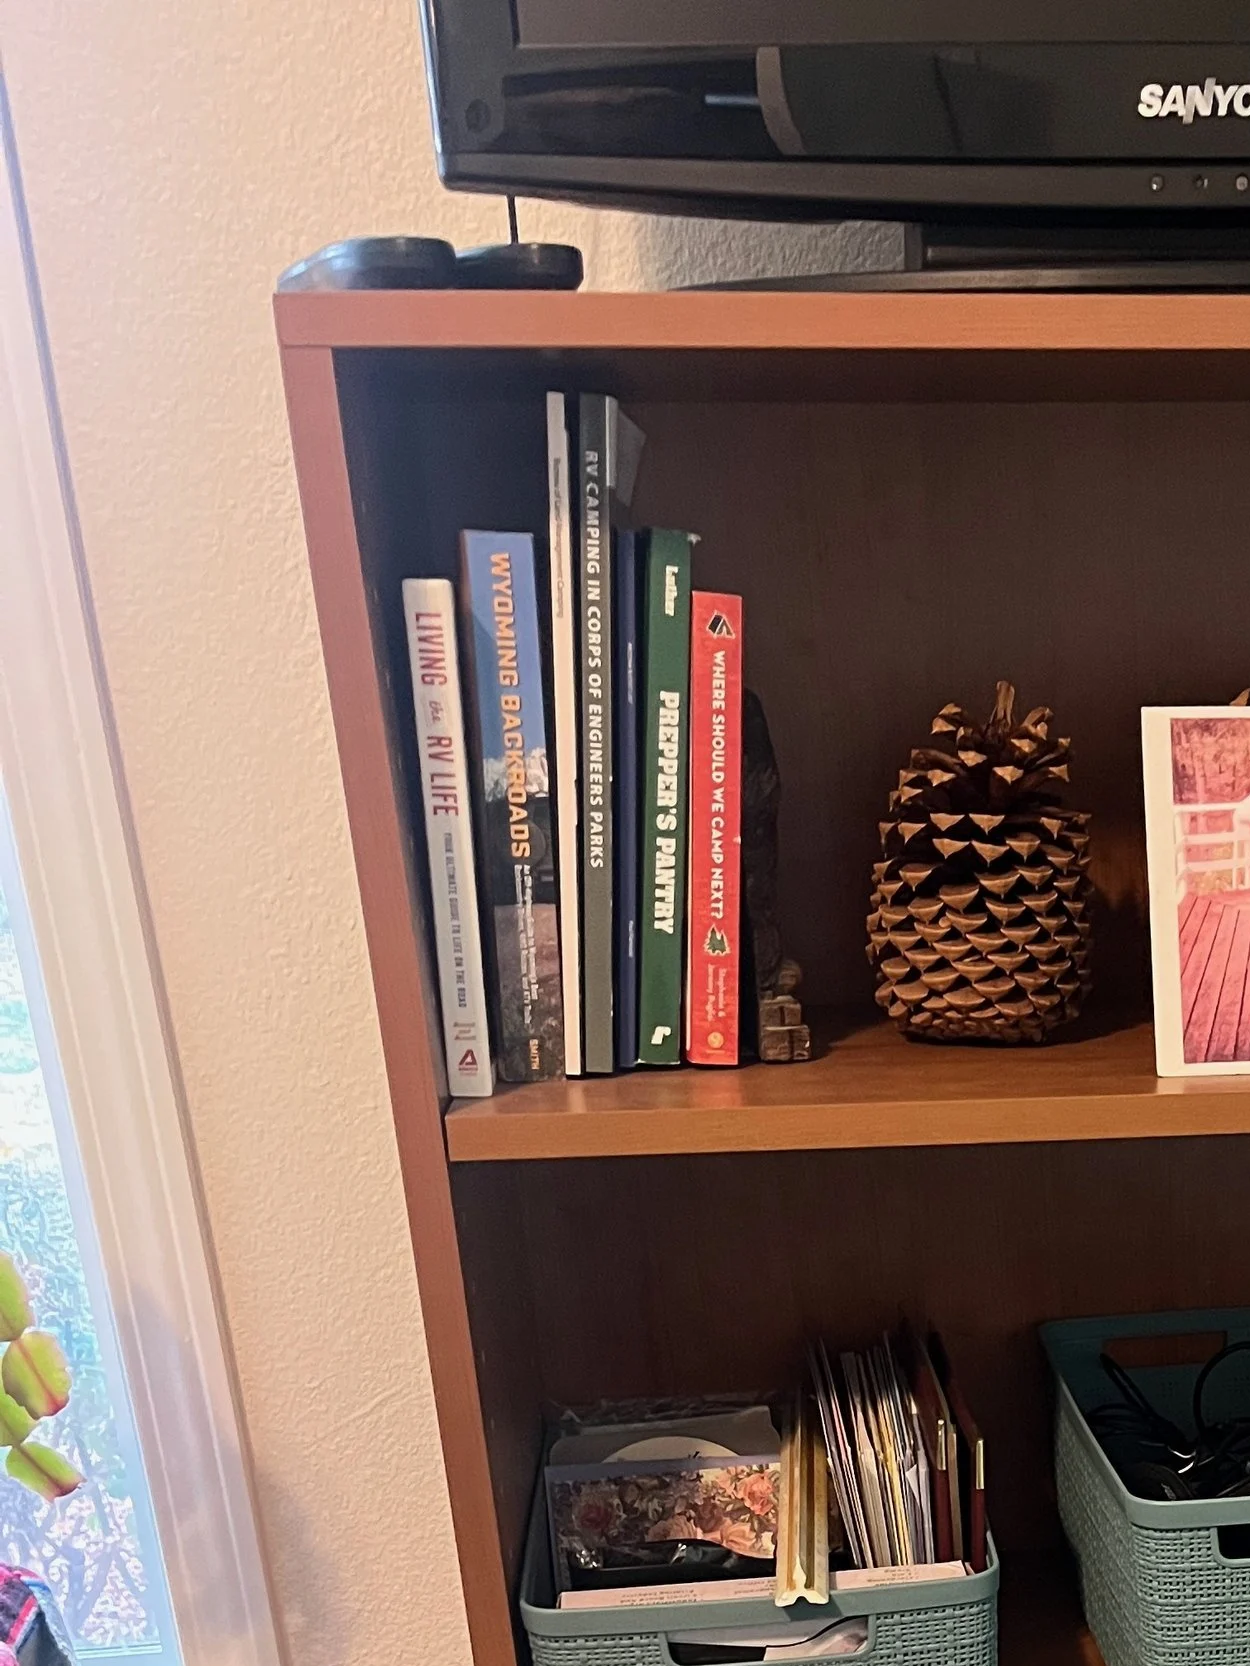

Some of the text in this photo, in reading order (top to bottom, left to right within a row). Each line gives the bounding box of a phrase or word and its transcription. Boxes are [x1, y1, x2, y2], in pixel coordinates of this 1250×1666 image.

[490, 552, 520, 688] WYOMING
[556, 579, 565, 618] Camping
[414, 611, 449, 724] LIVING the
[585, 450, 604, 868] RV CAMPING IN CORPS OF ENGINEERS PARKS
[426, 735, 460, 817] RV LIFE
[501, 694, 531, 859] BACKROADS
[653, 690, 680, 934] PREPPER'S PANTRY
[710, 650, 726, 920] WHERE SHOULD WE CAMP NEXT?
[452, 936, 463, 954] LIFE
[456, 970, 466, 985] THE
[529, 1039, 541, 1070] SMITH
